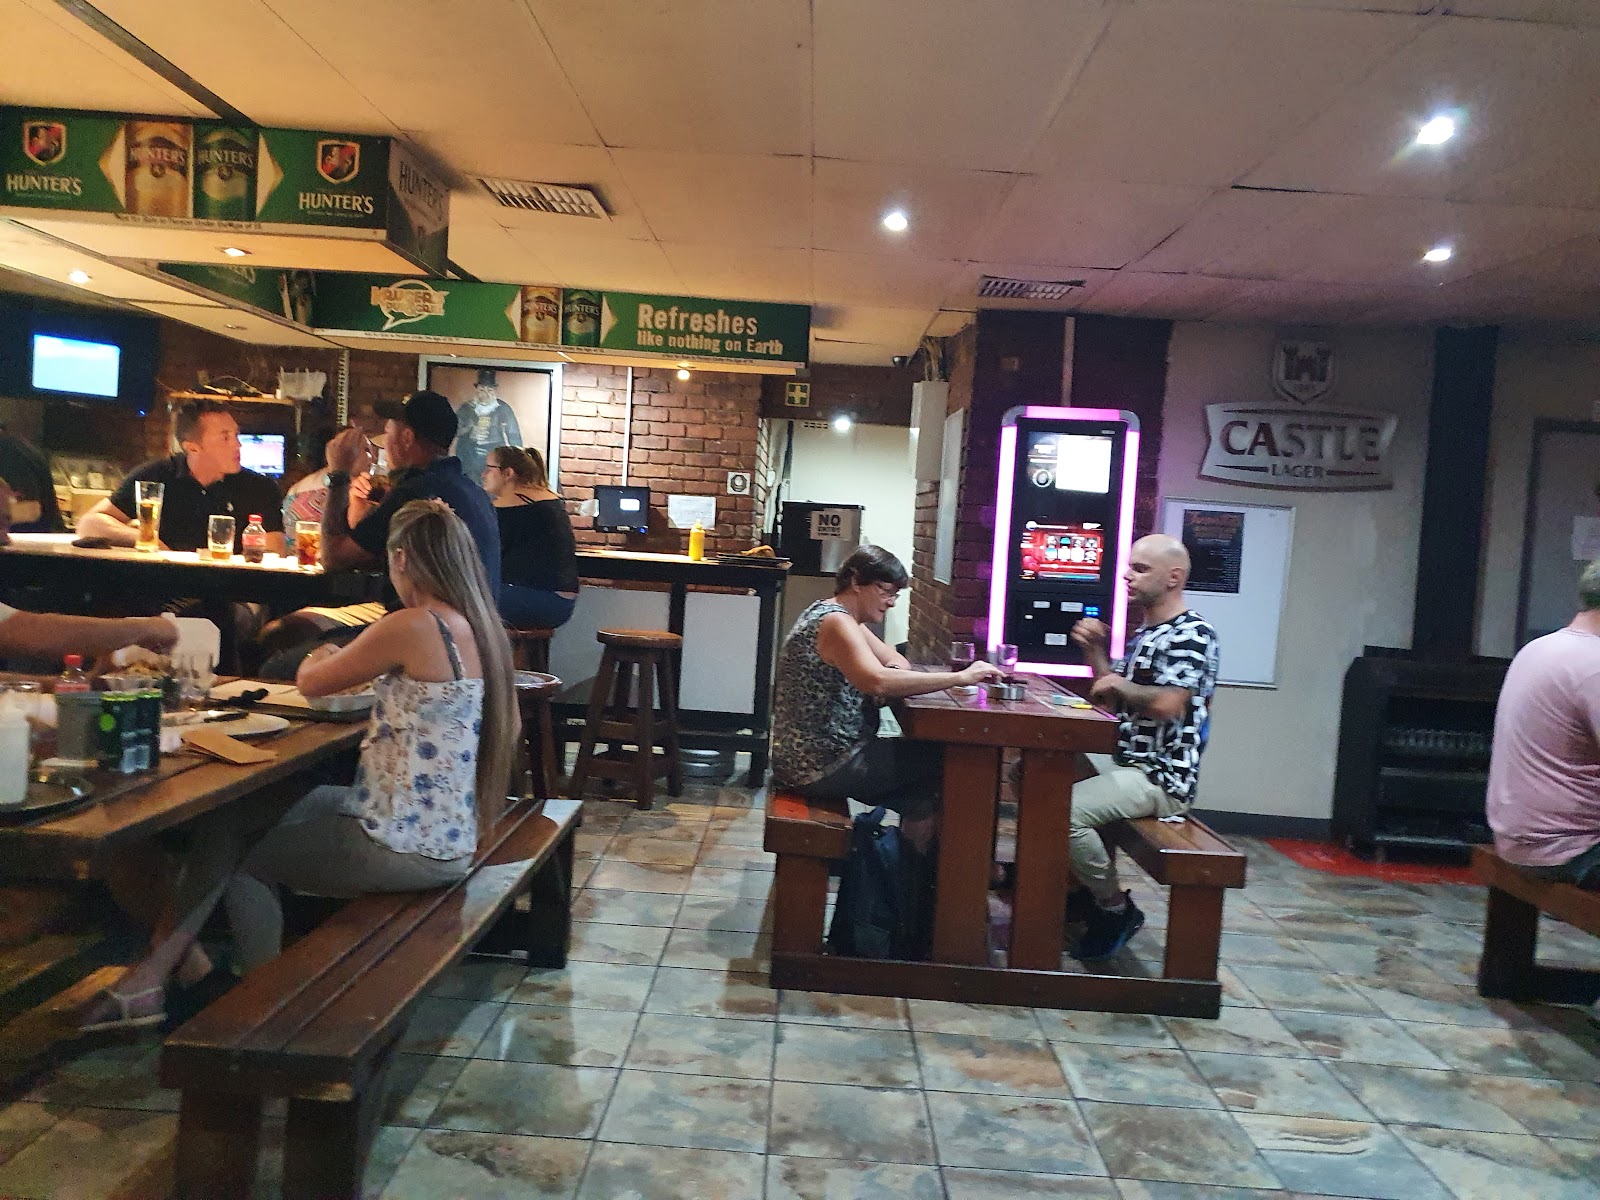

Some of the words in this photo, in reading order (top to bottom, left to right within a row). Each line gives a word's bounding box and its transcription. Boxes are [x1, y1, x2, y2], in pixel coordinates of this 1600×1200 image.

[298, 191, 375, 215] HUNTER'S
[638, 303, 759, 336] Refreshes
[636, 329, 664, 348] like
[668, 333, 721, 353] nothing
[725, 340, 742, 352] on
[746, 338, 784, 355] Earth
[1219, 420, 1380, 462] CASTLE
[1271, 463, 1325, 478] LAGER
[818, 514, 841, 527] NO
